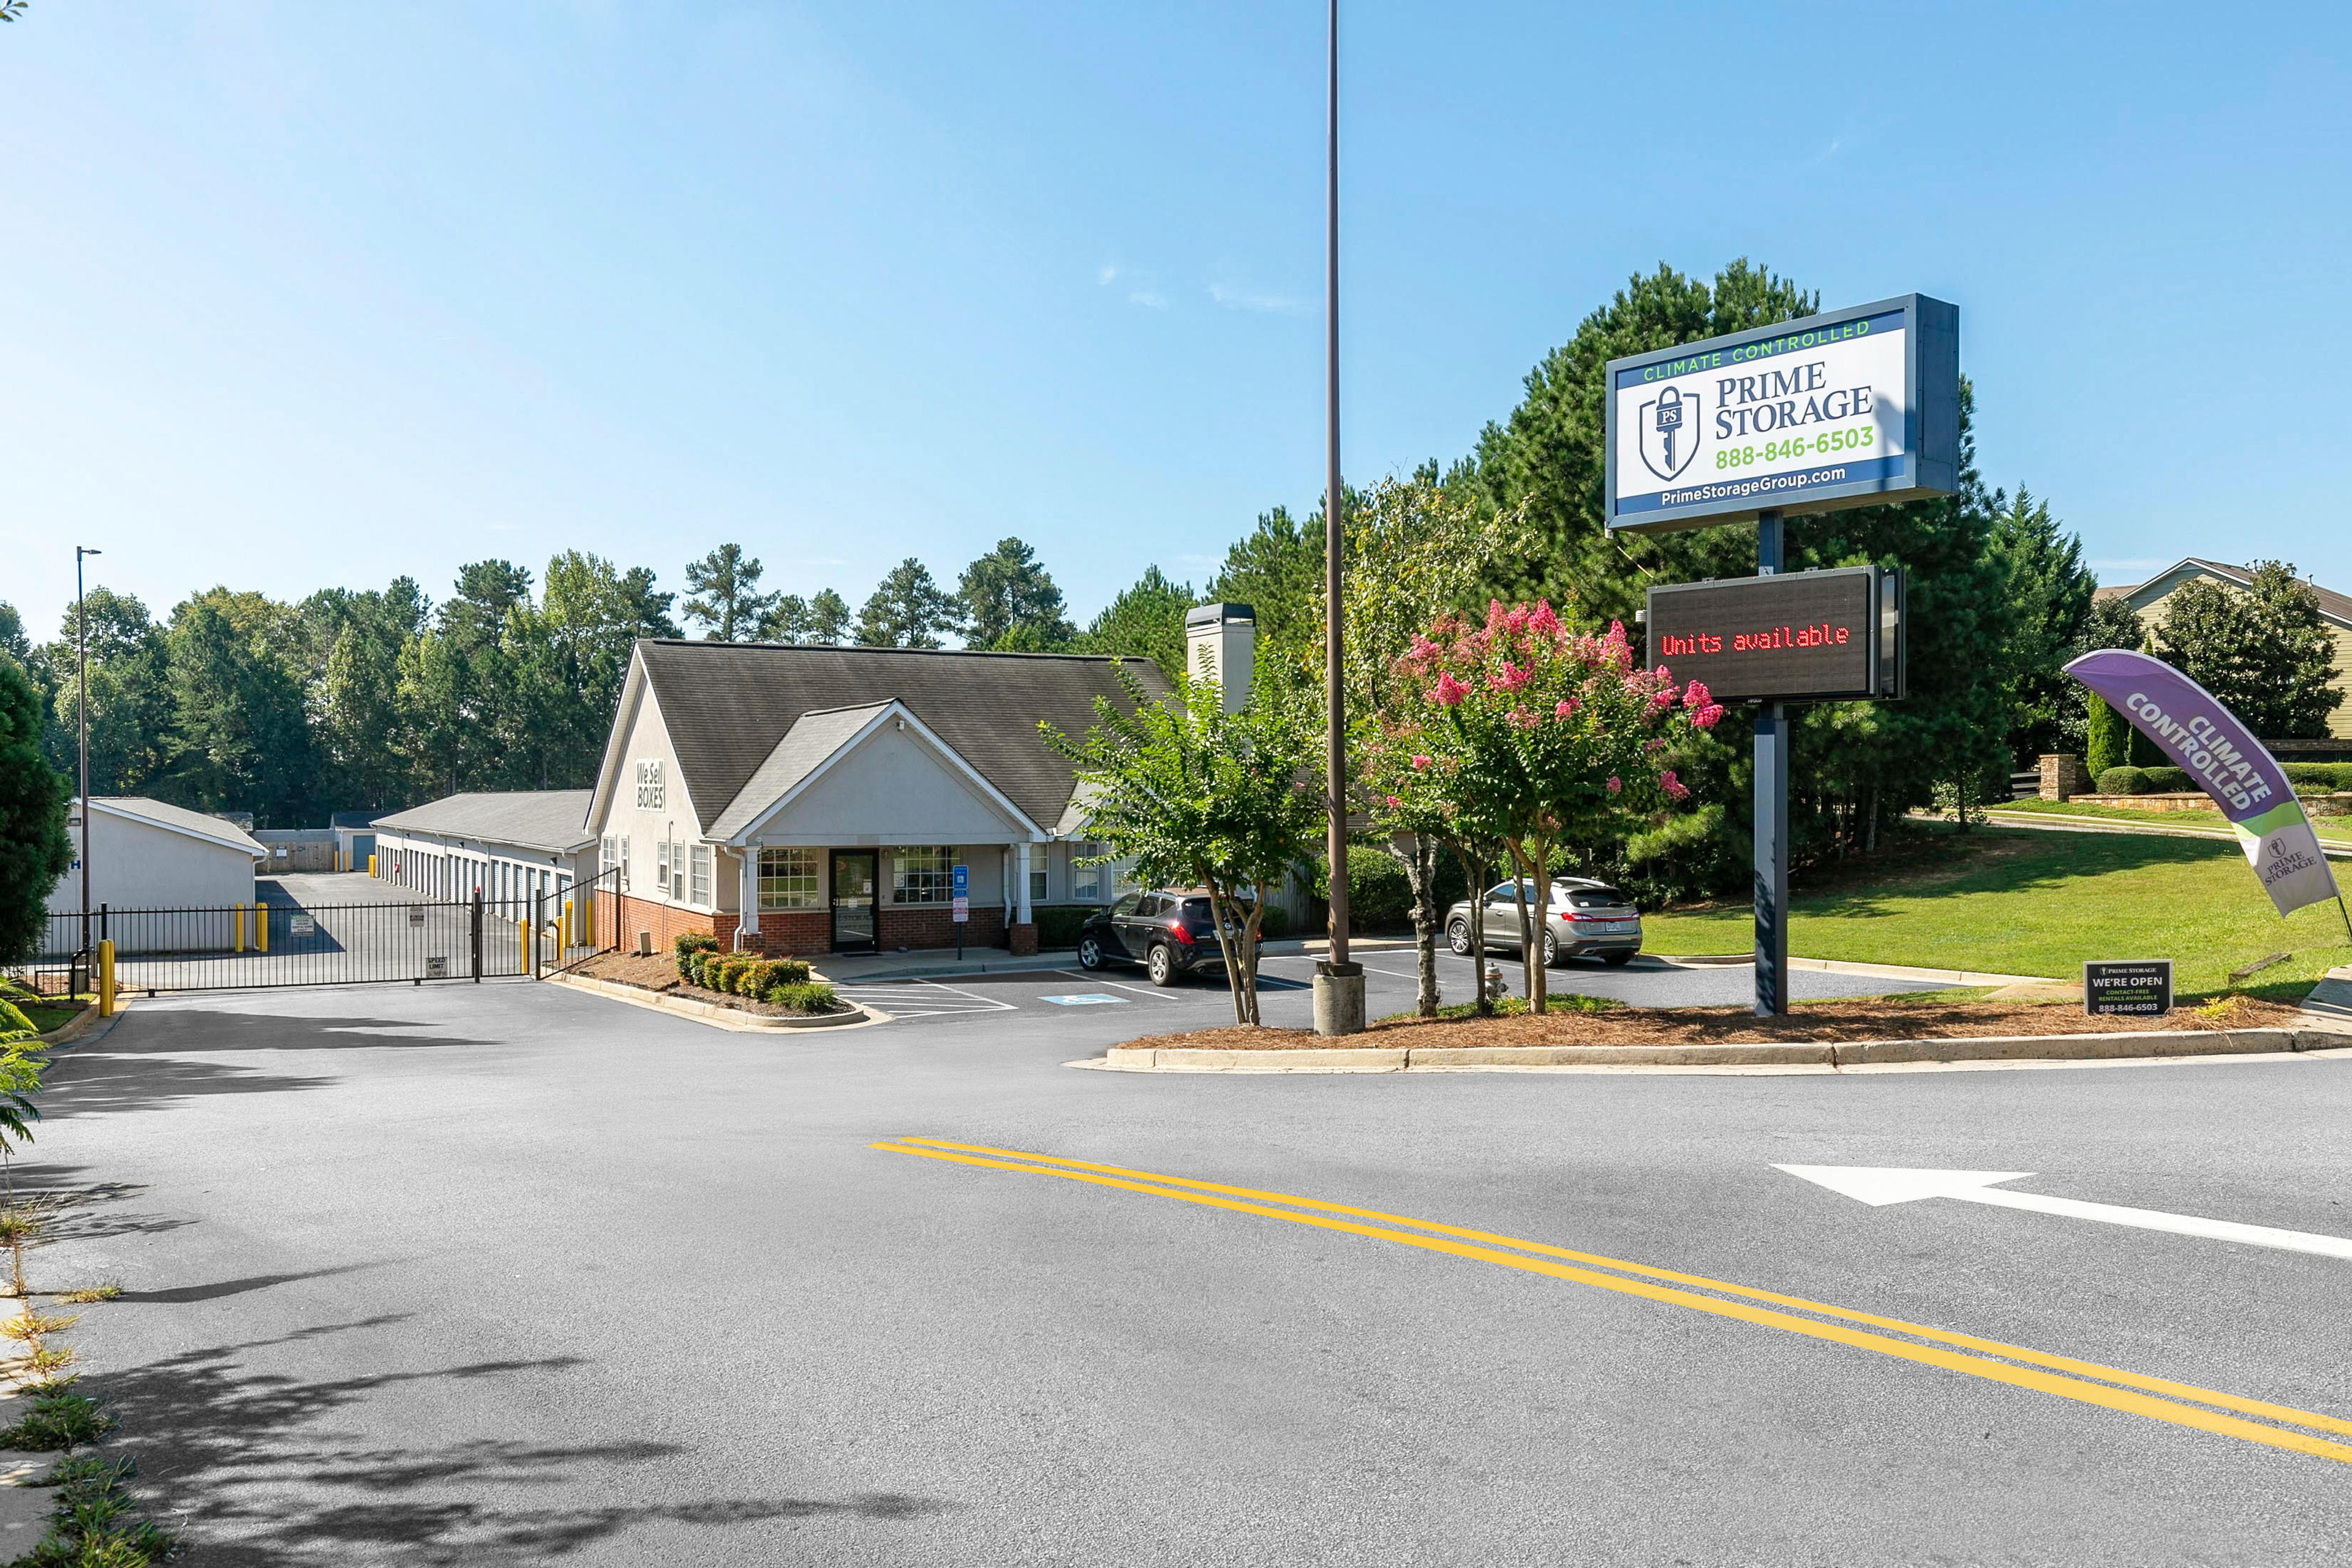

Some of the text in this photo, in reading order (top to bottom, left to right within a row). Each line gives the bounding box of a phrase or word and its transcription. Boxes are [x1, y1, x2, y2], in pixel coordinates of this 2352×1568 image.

[1643, 320, 1870, 382] CLIMATE CONTROLLED
[1716, 361, 1827, 409] PRIME
[1662, 409, 1678, 423] PS
[1716, 385, 1874, 440] STORAGE
[1716, 426, 1874, 470] 888-846-6503
[1661, 467, 1846, 505] PrimeStorageGroup.com
[1661, 623, 1850, 656] Units available
[2126, 692, 2252, 810] CONTROLLED
[2188, 716, 2272, 803] CLIMATE
[637, 761, 663, 784] We Sell
[637, 786, 663, 809] BOXES
[2265, 856, 2317, 886] STORAGE
[2267, 851, 2305, 875] PRIME
[2092, 977, 2163, 987] WE'RE OPEN
[2098, 1003, 2158, 1012] 888-846-6503
